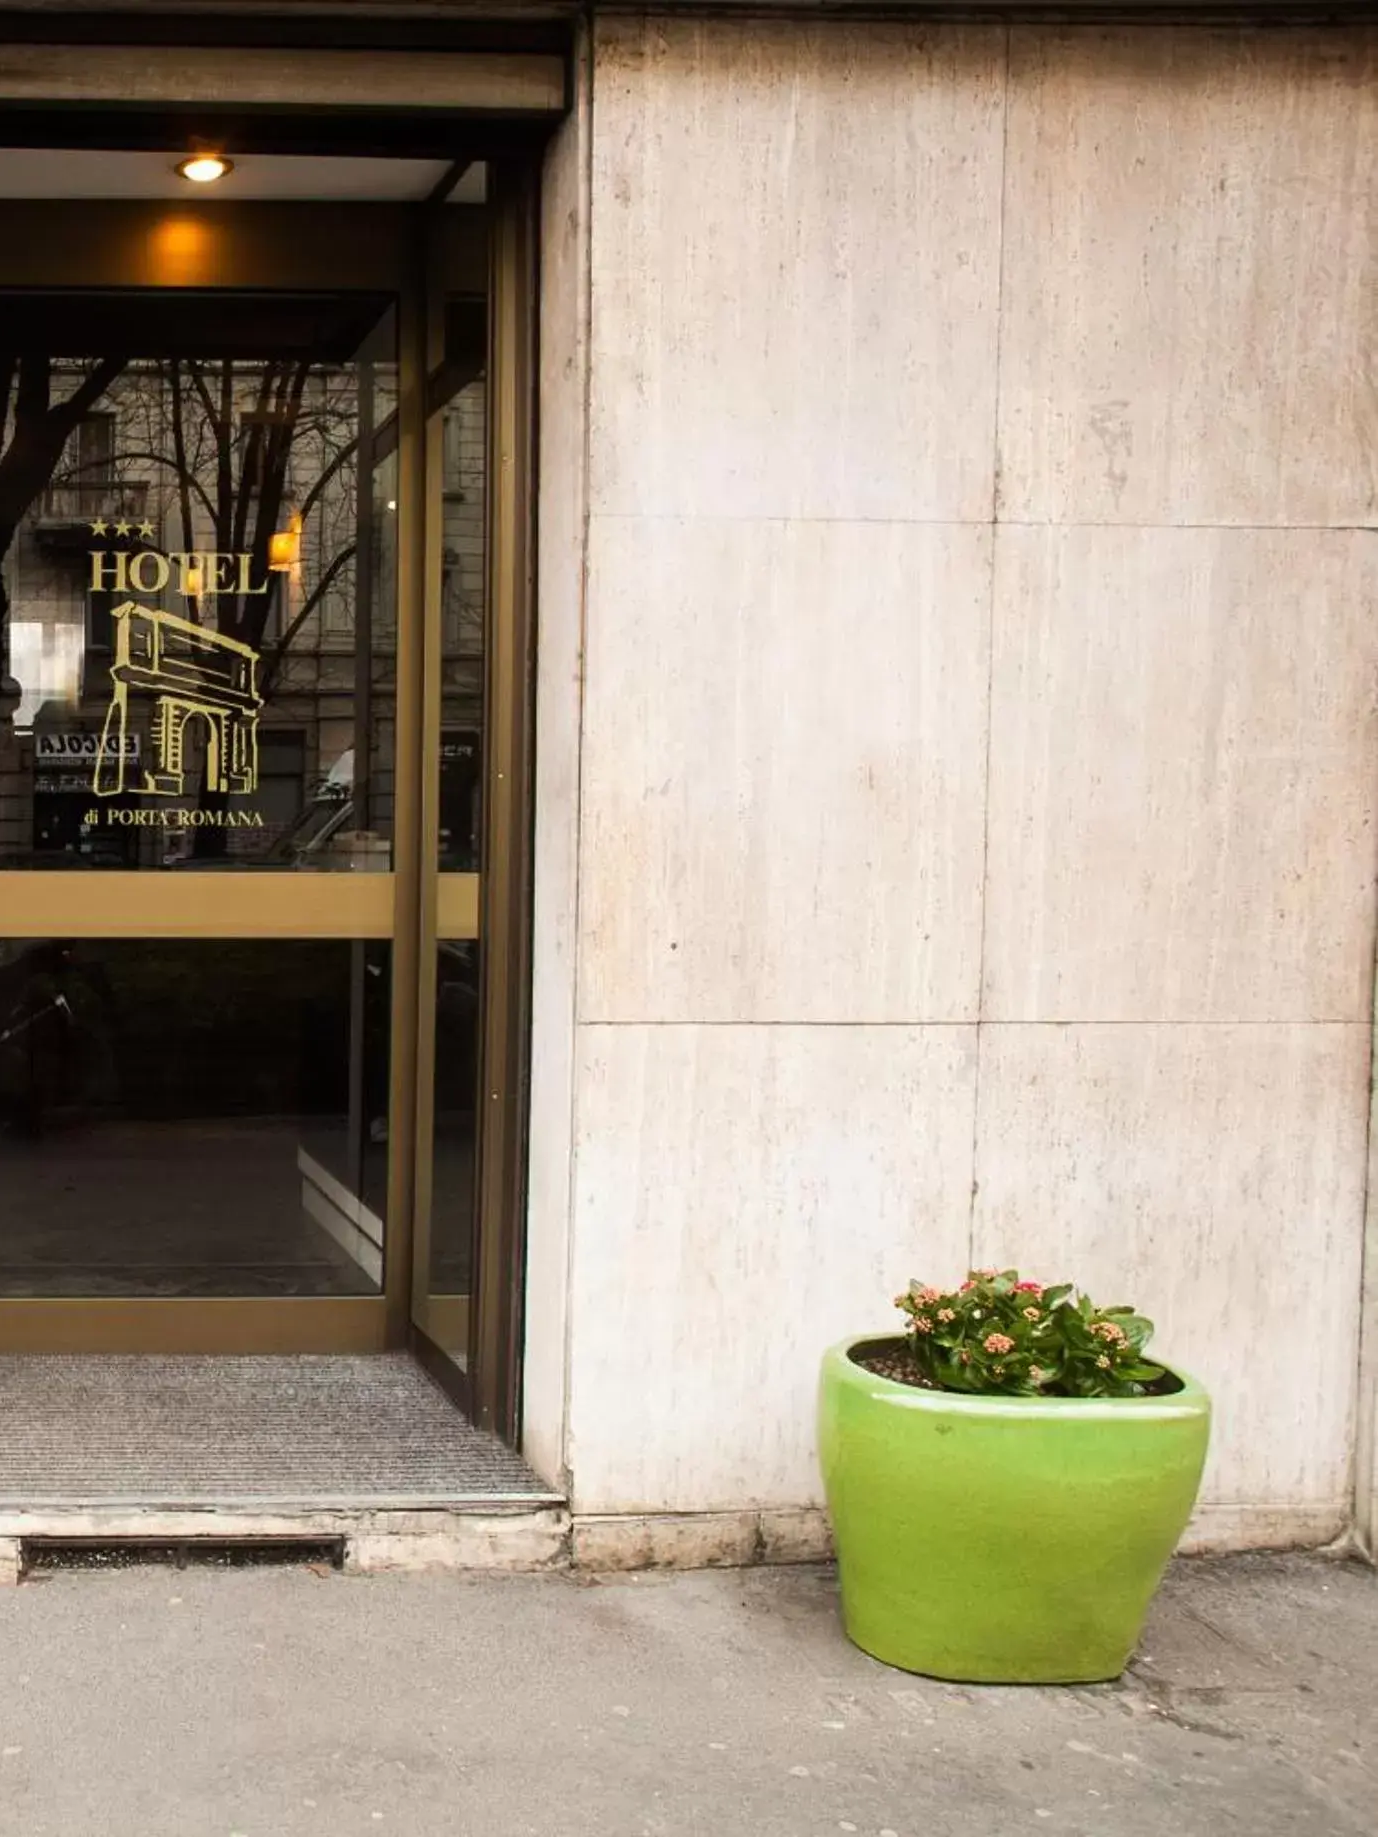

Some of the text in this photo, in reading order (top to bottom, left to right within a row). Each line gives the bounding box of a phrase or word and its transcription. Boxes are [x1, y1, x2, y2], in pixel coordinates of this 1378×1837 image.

[88, 551, 268, 593] HOTEL
[83, 808, 264, 827] di PORTA ROMANA
